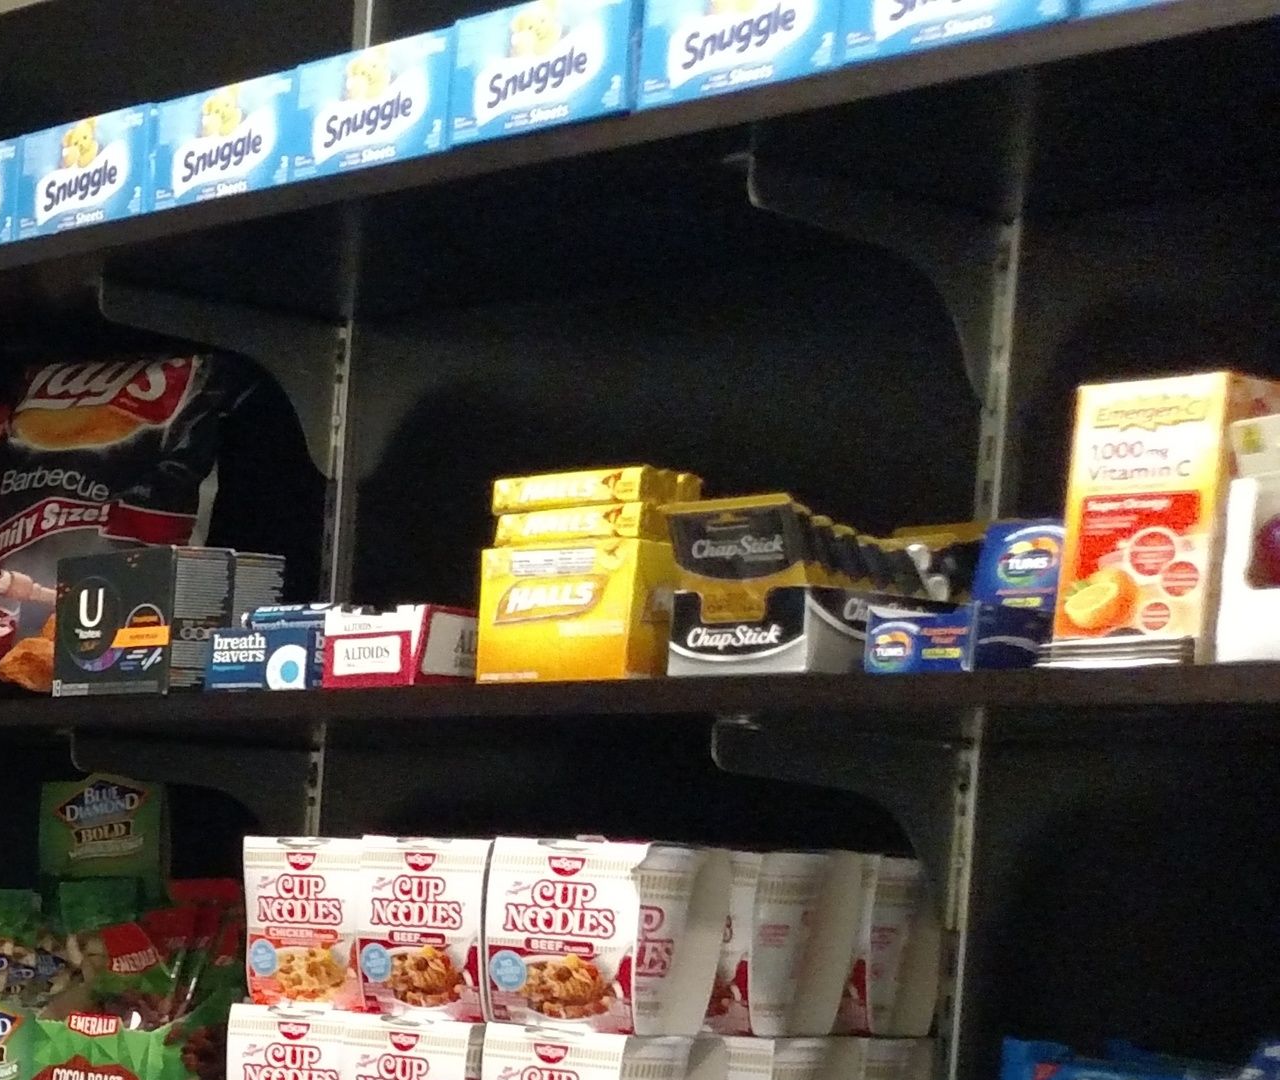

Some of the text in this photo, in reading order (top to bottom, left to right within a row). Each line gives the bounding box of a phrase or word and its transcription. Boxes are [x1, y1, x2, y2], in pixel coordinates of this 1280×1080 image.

[681, 2, 797, 70] Snuggle
[486, 45, 588, 109] Snuggle
[323, 92, 413, 150] Snuggle
[182, 129, 264, 184] Snuggle
[42, 159, 119, 213] Snuggle
[1176, 459, 1192, 478] C
[0, 464, 111, 502] Barbecue
[40, 502, 112, 533] Size!
[691, 533, 785, 560] ChapStick
[79, 587, 104, 629] U
[213, 632, 267, 650] breath
[686, 623, 783, 651] ChapStick
[212, 648, 266, 665] savers
[342, 645, 391, 662] ALTOIDS
[64, 791, 140, 823] DIAMOND
[83, 785, 120, 803] BLUE
[79, 822, 126, 844] BOLD
[276, 874, 326, 901] CUP
[392, 874, 445, 902] CUP
[531, 879, 596, 910] CUP
[257, 897, 343, 925] NOODLES
[371, 899, 462, 930] NOODLES
[503, 903, 616, 939] NOODLES
[392, 931, 421, 944] BEEF
[530, 938, 564, 952] BEEF
[69, 1014, 117, 1035] EMERALD
[265, 1043, 321, 1070] CUP
